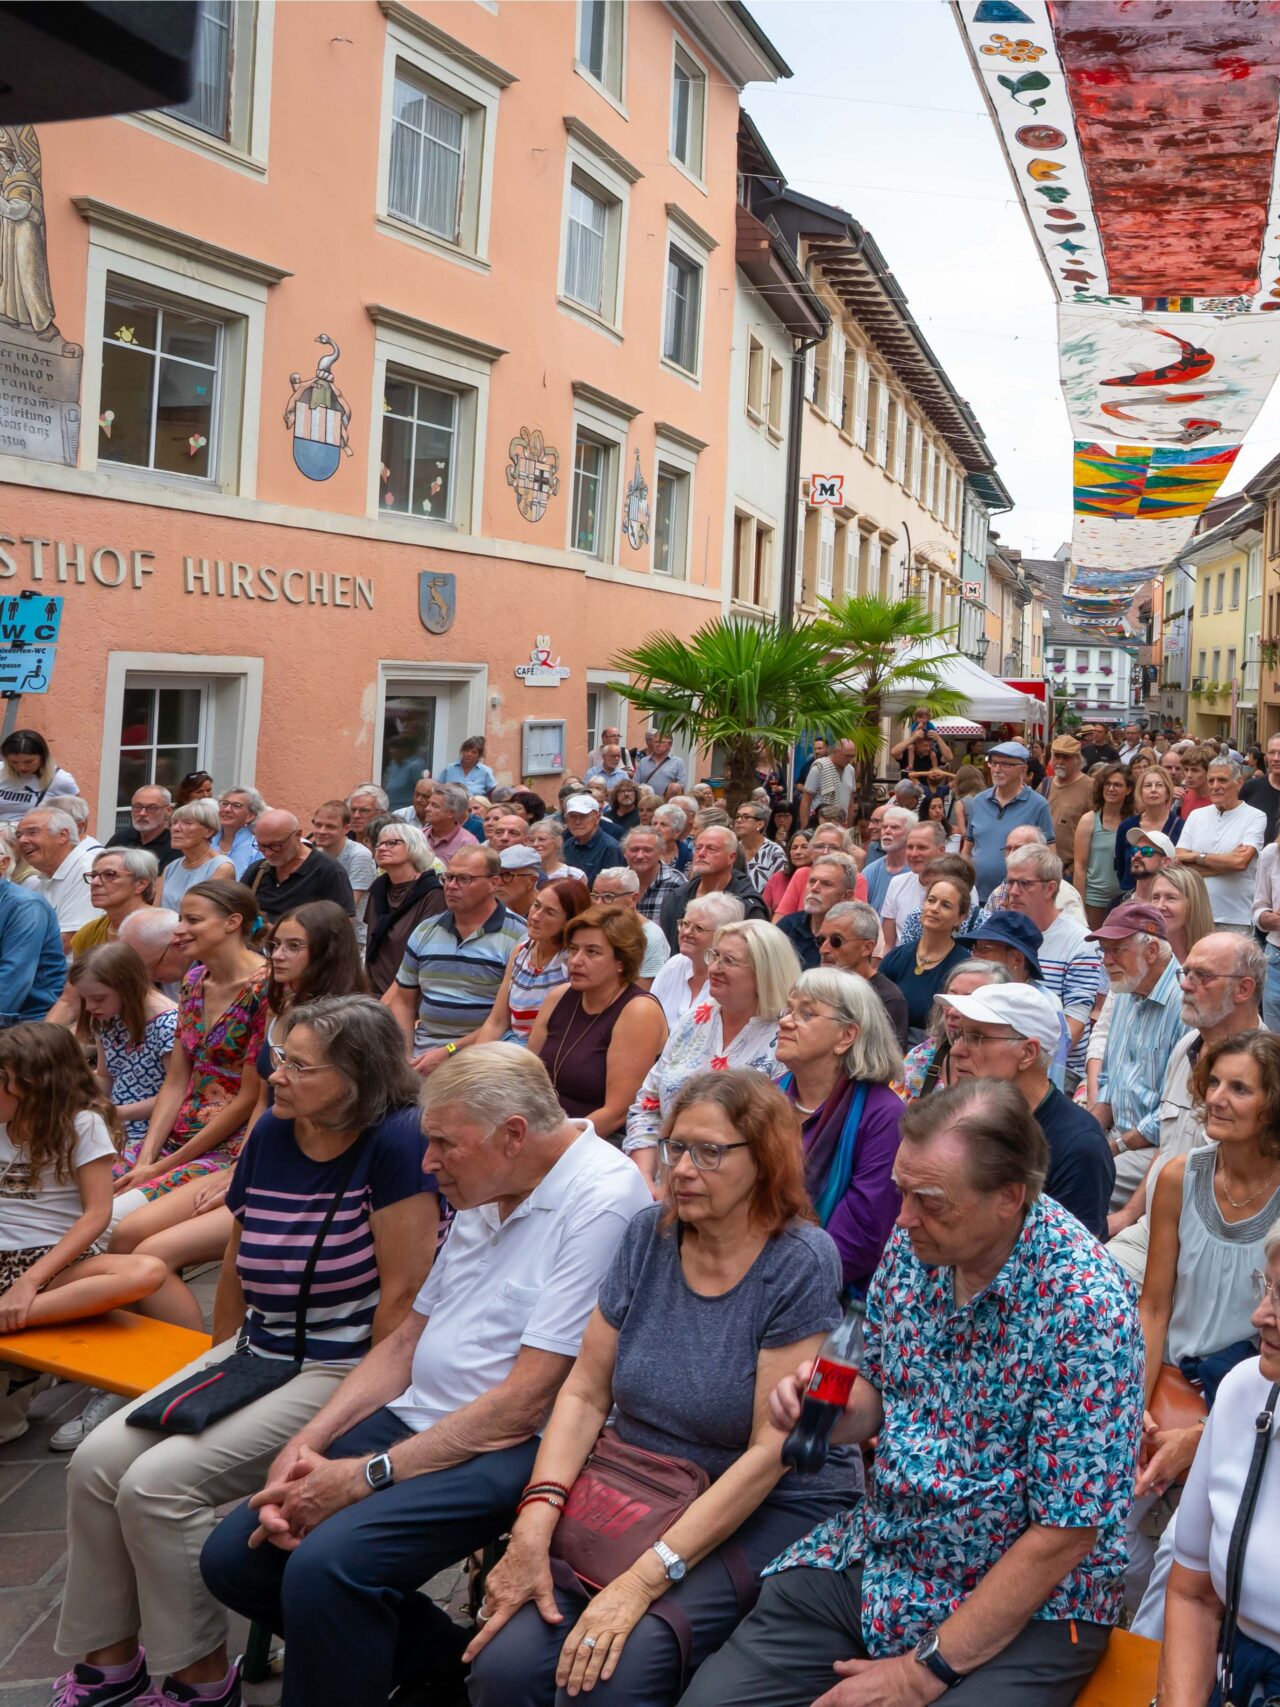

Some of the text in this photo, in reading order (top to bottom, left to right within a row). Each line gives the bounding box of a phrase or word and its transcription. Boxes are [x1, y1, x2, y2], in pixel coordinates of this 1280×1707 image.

[0, 406, 52, 426] gleitung
[819, 483, 836, 497] M
[0, 533, 375, 611] STHOF HIRSCHEN
[0, 789, 33, 803] PUMA
